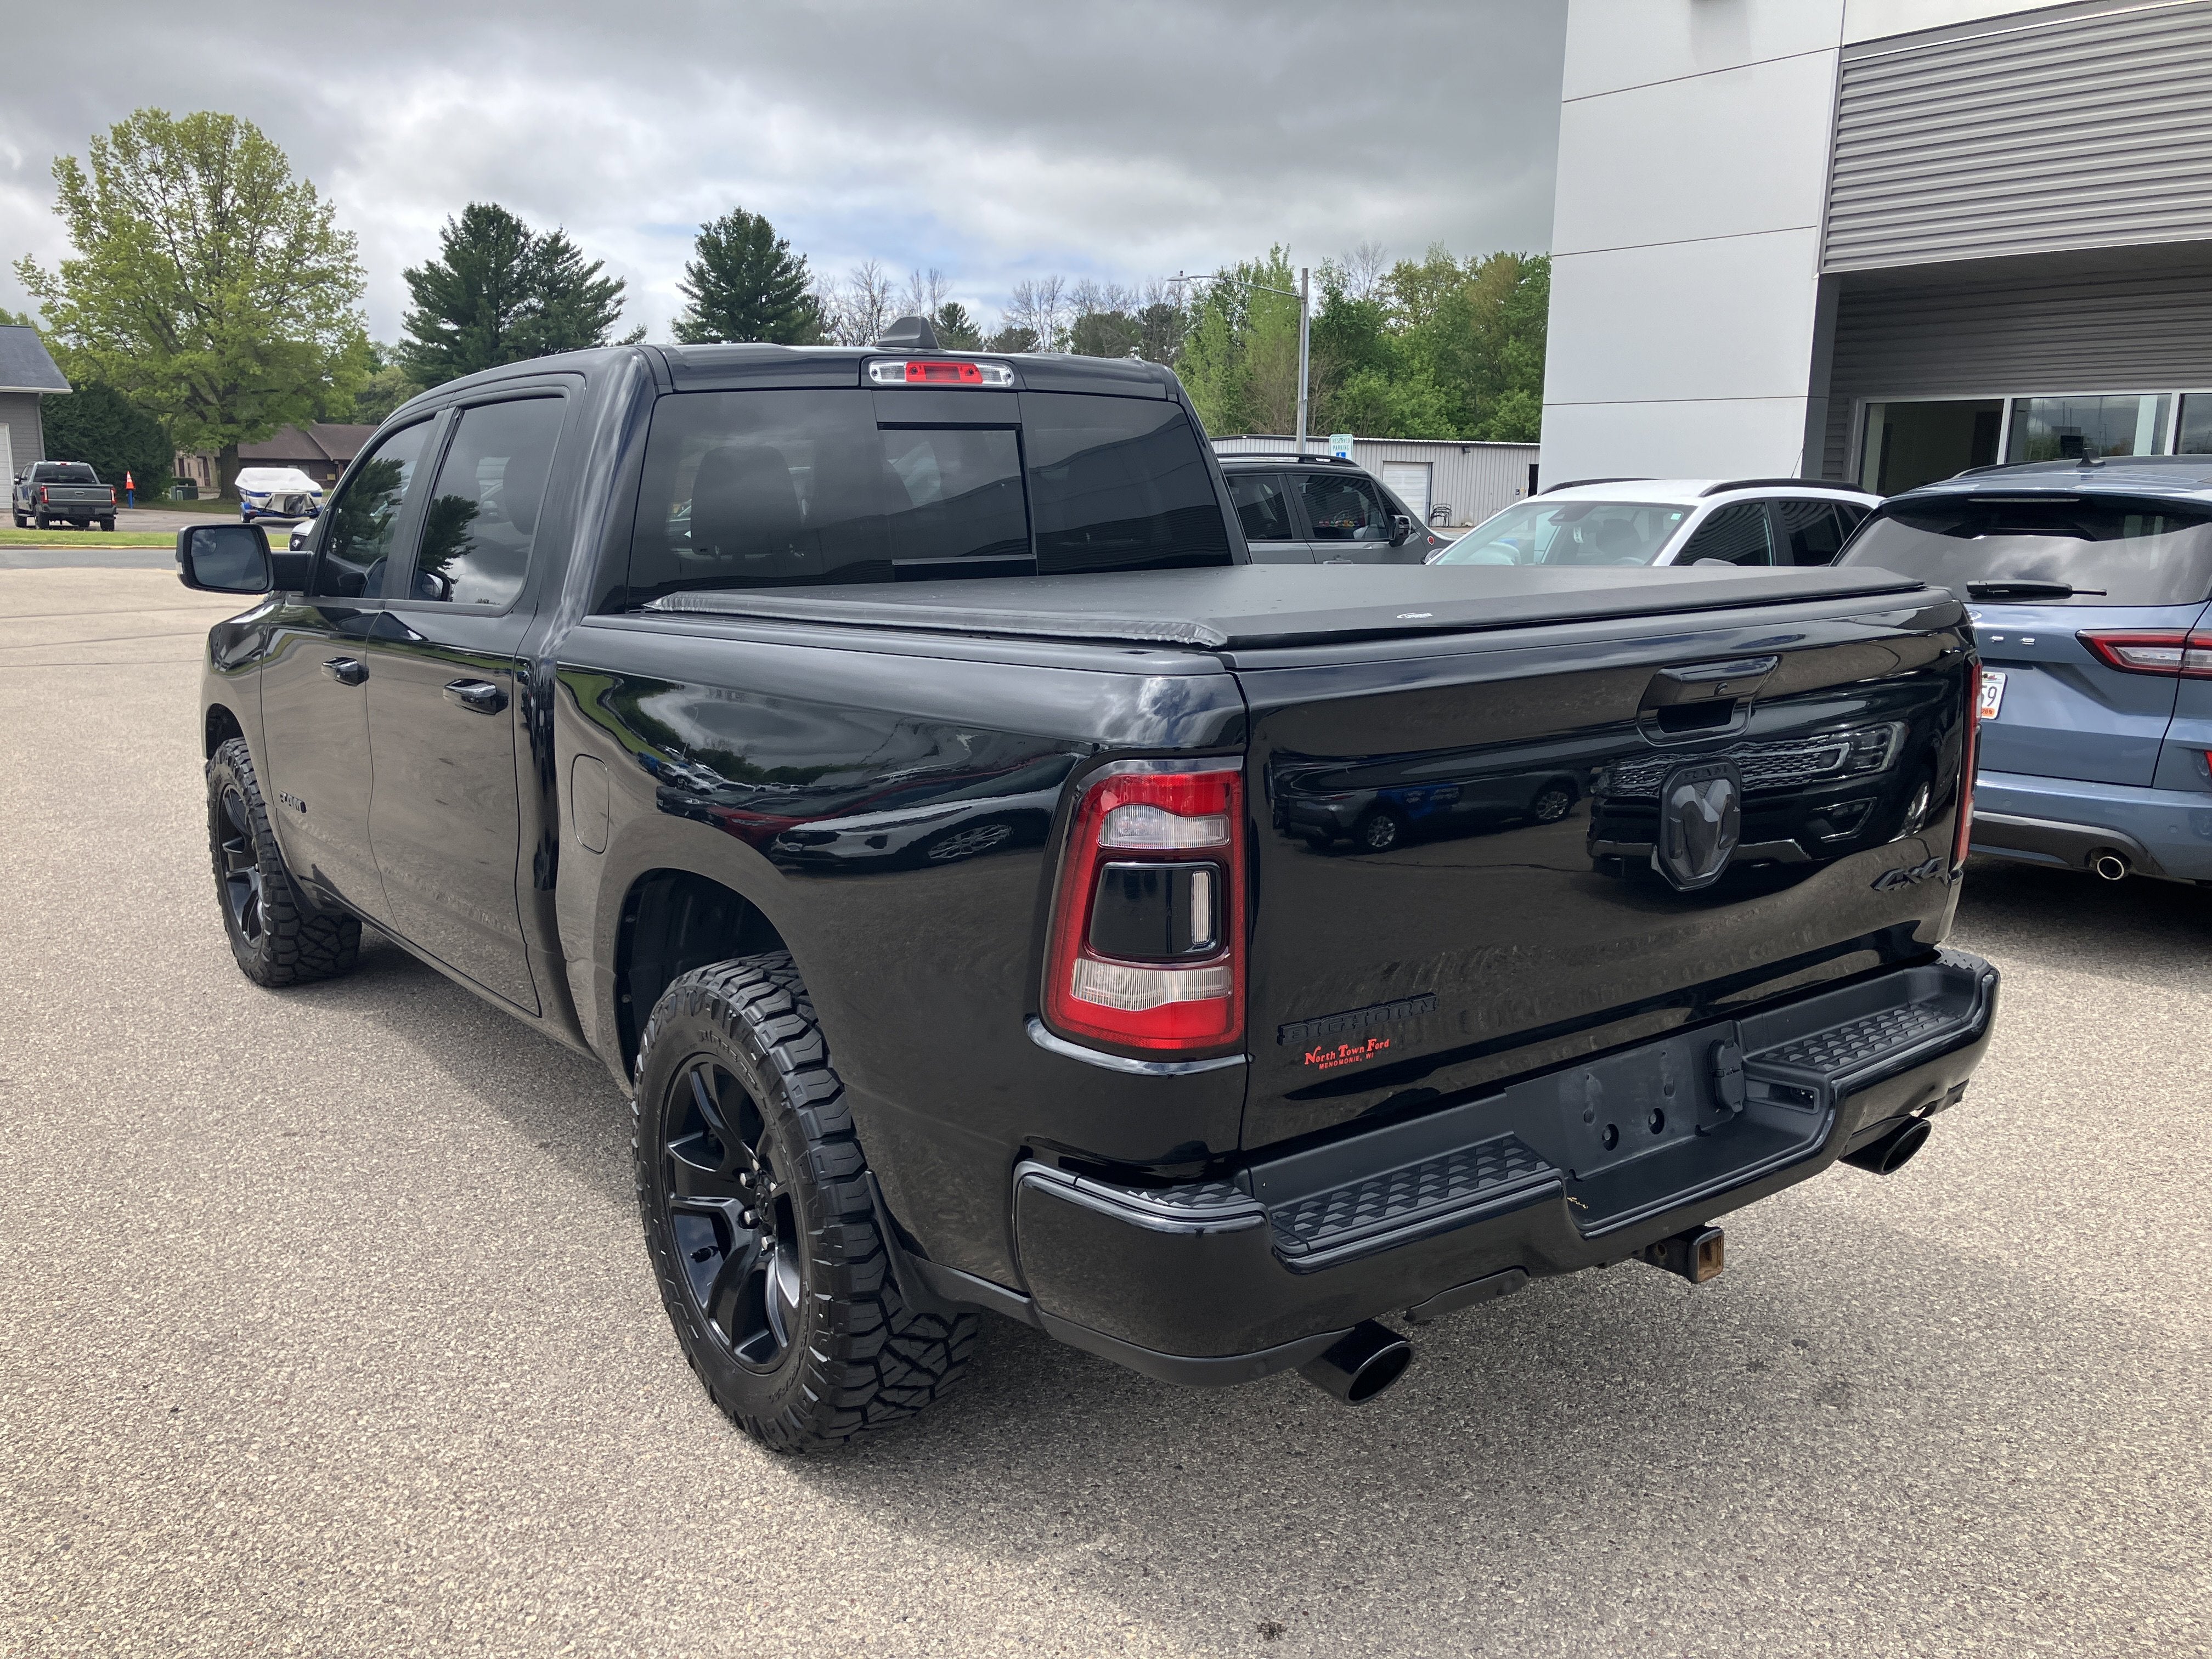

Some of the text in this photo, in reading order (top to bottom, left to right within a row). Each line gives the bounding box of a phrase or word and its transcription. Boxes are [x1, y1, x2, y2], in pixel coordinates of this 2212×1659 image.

[1684, 766, 1727, 778] RAM
[280, 790, 307, 813] RAM
[1304, 1037, 1390, 1065] North Town Ford
[1319, 1055, 1363, 1070] MENOMONIE,
